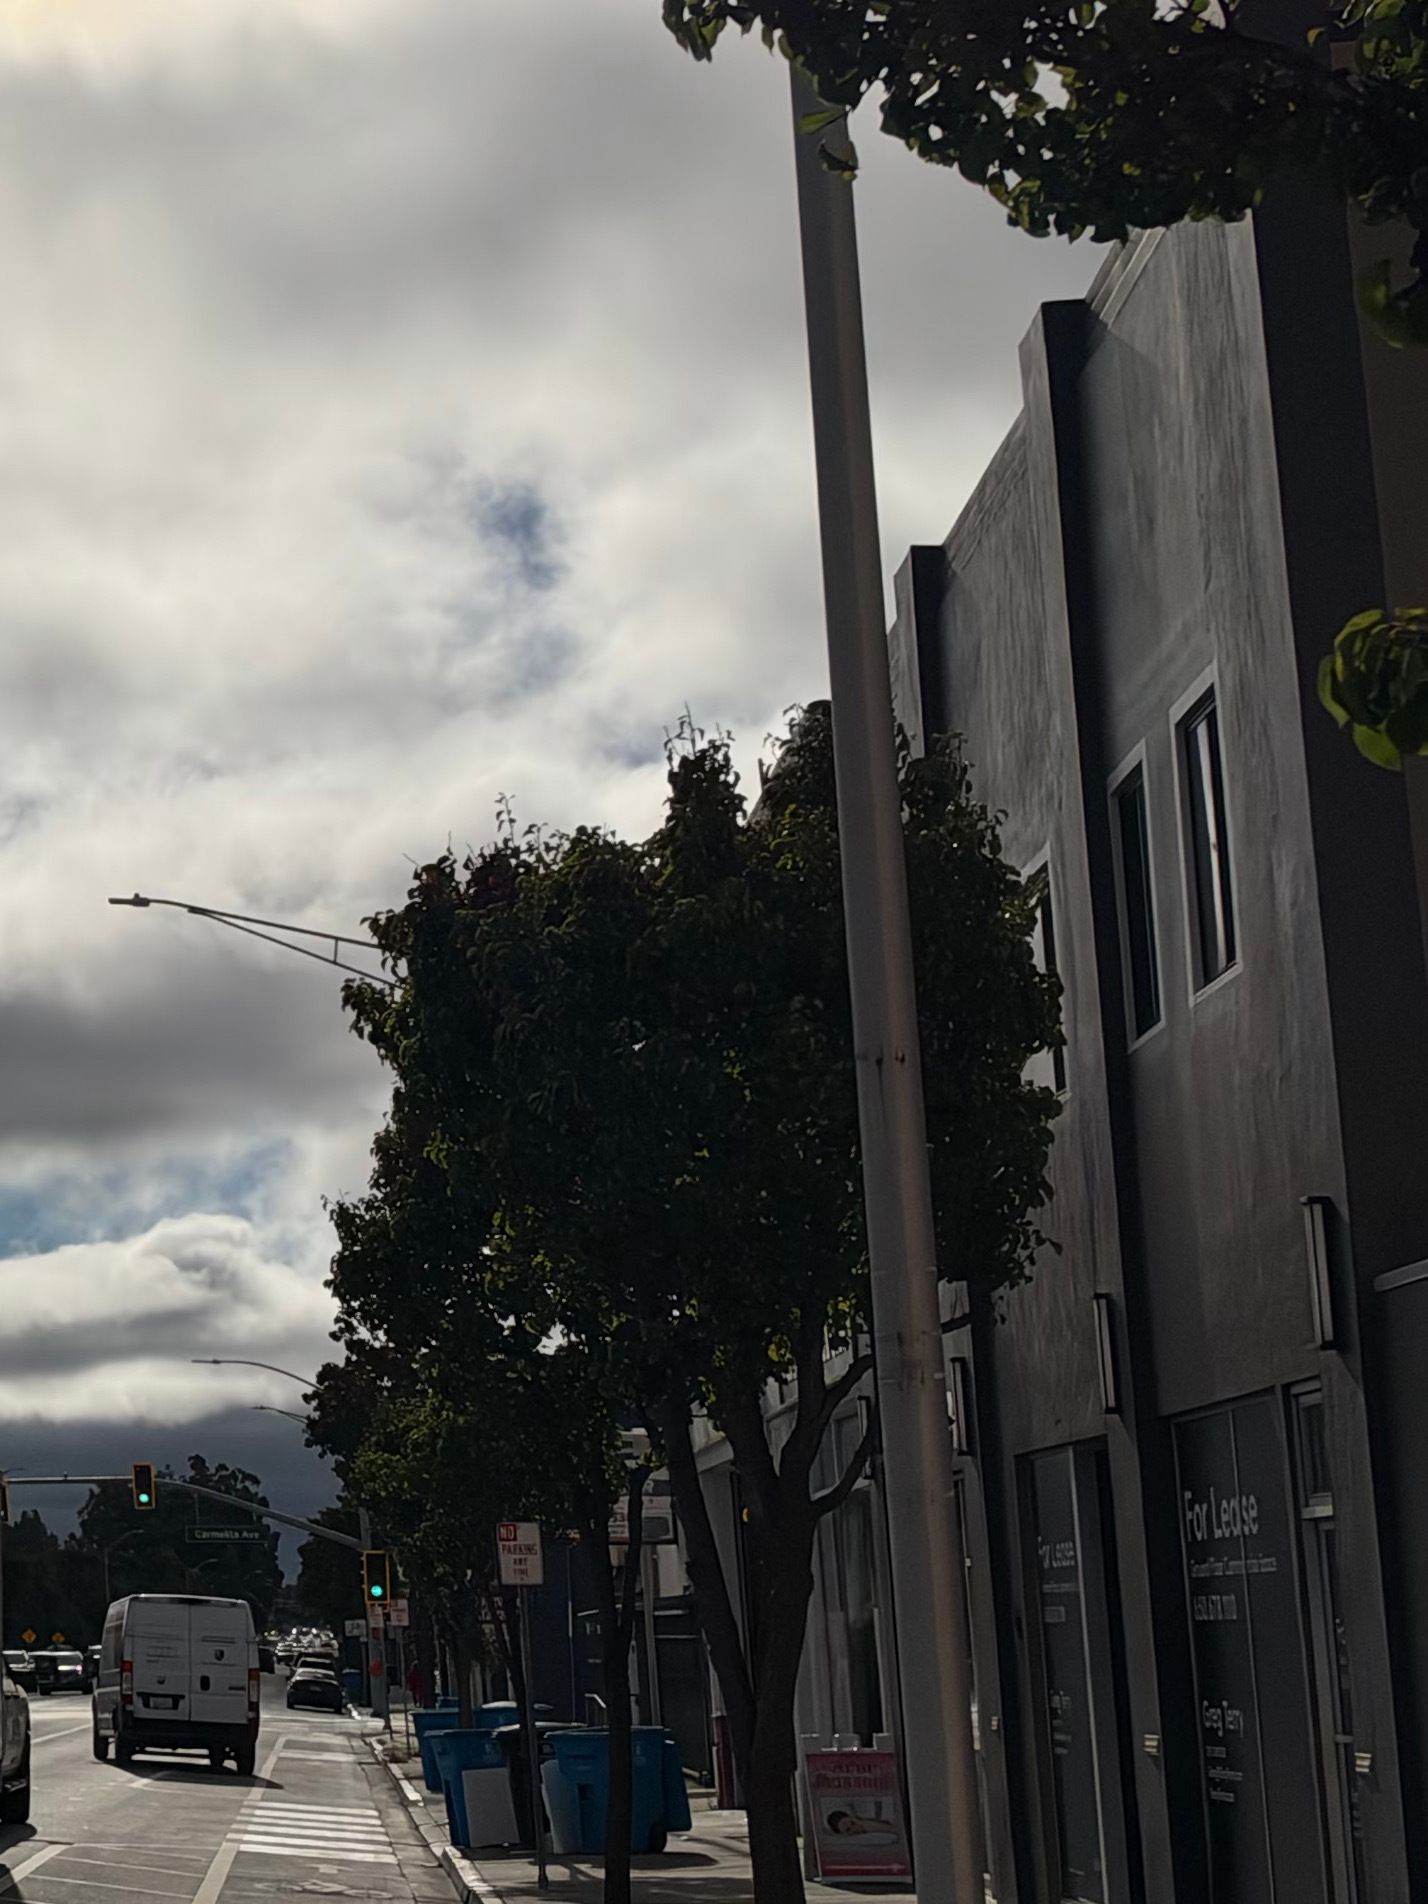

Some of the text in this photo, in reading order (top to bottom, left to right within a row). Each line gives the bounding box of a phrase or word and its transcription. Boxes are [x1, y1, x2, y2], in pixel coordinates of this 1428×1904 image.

[1184, 1486, 1259, 1542] For Lease
[241, 1529, 260, 1540] Ave
[499, 1525, 515, 1540] NO
[501, 1543, 538, 1555] PARKING
[513, 1557, 528, 1566] ANY
[513, 1567, 529, 1578] TIME
